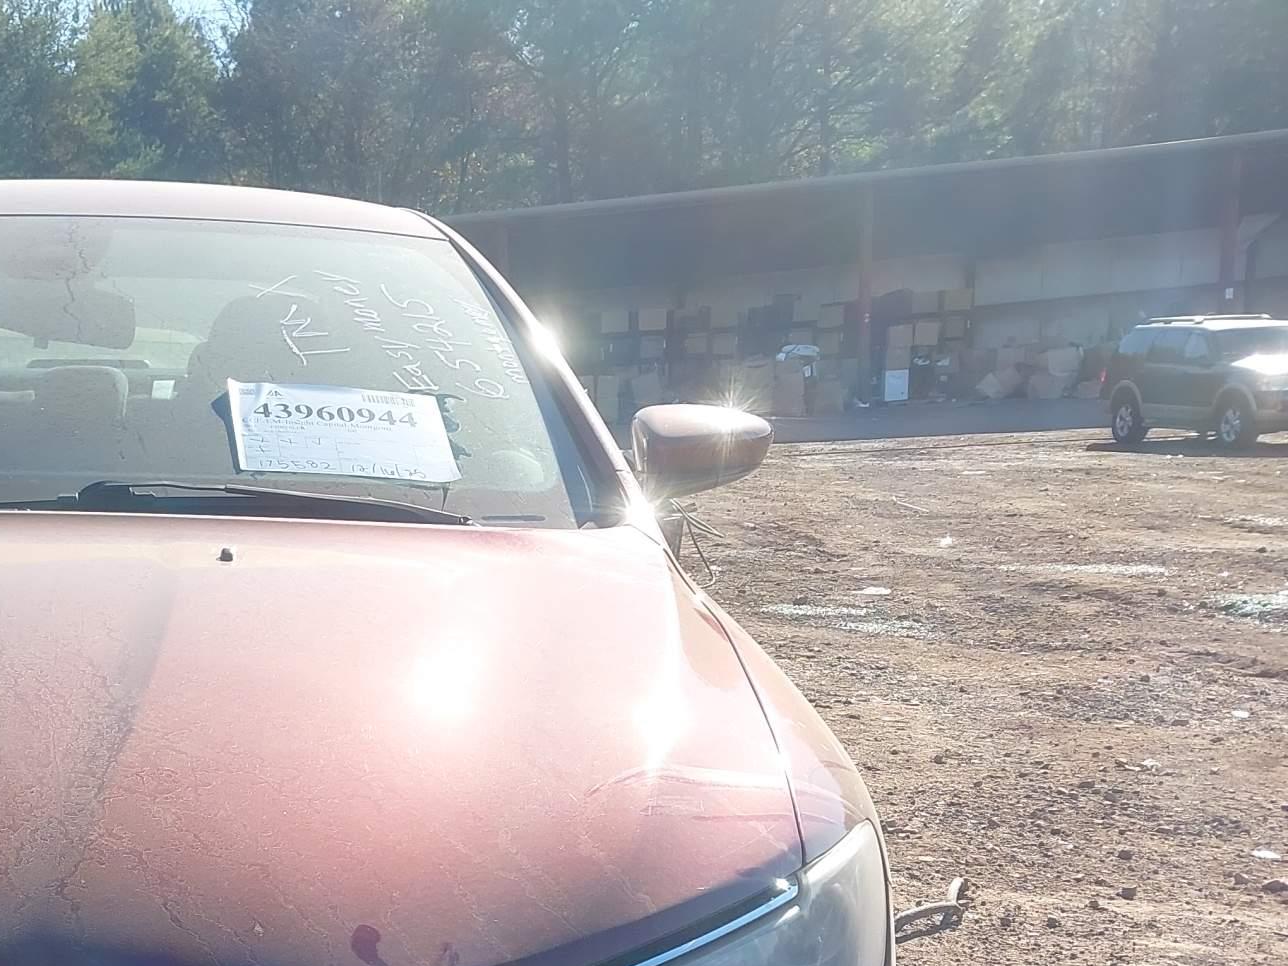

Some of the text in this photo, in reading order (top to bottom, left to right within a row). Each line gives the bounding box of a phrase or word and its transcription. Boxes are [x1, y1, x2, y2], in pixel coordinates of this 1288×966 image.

[374, 335, 440, 390] Easy
[381, 283, 510, 400] 654215
[253, 402, 418, 428] 43960944
